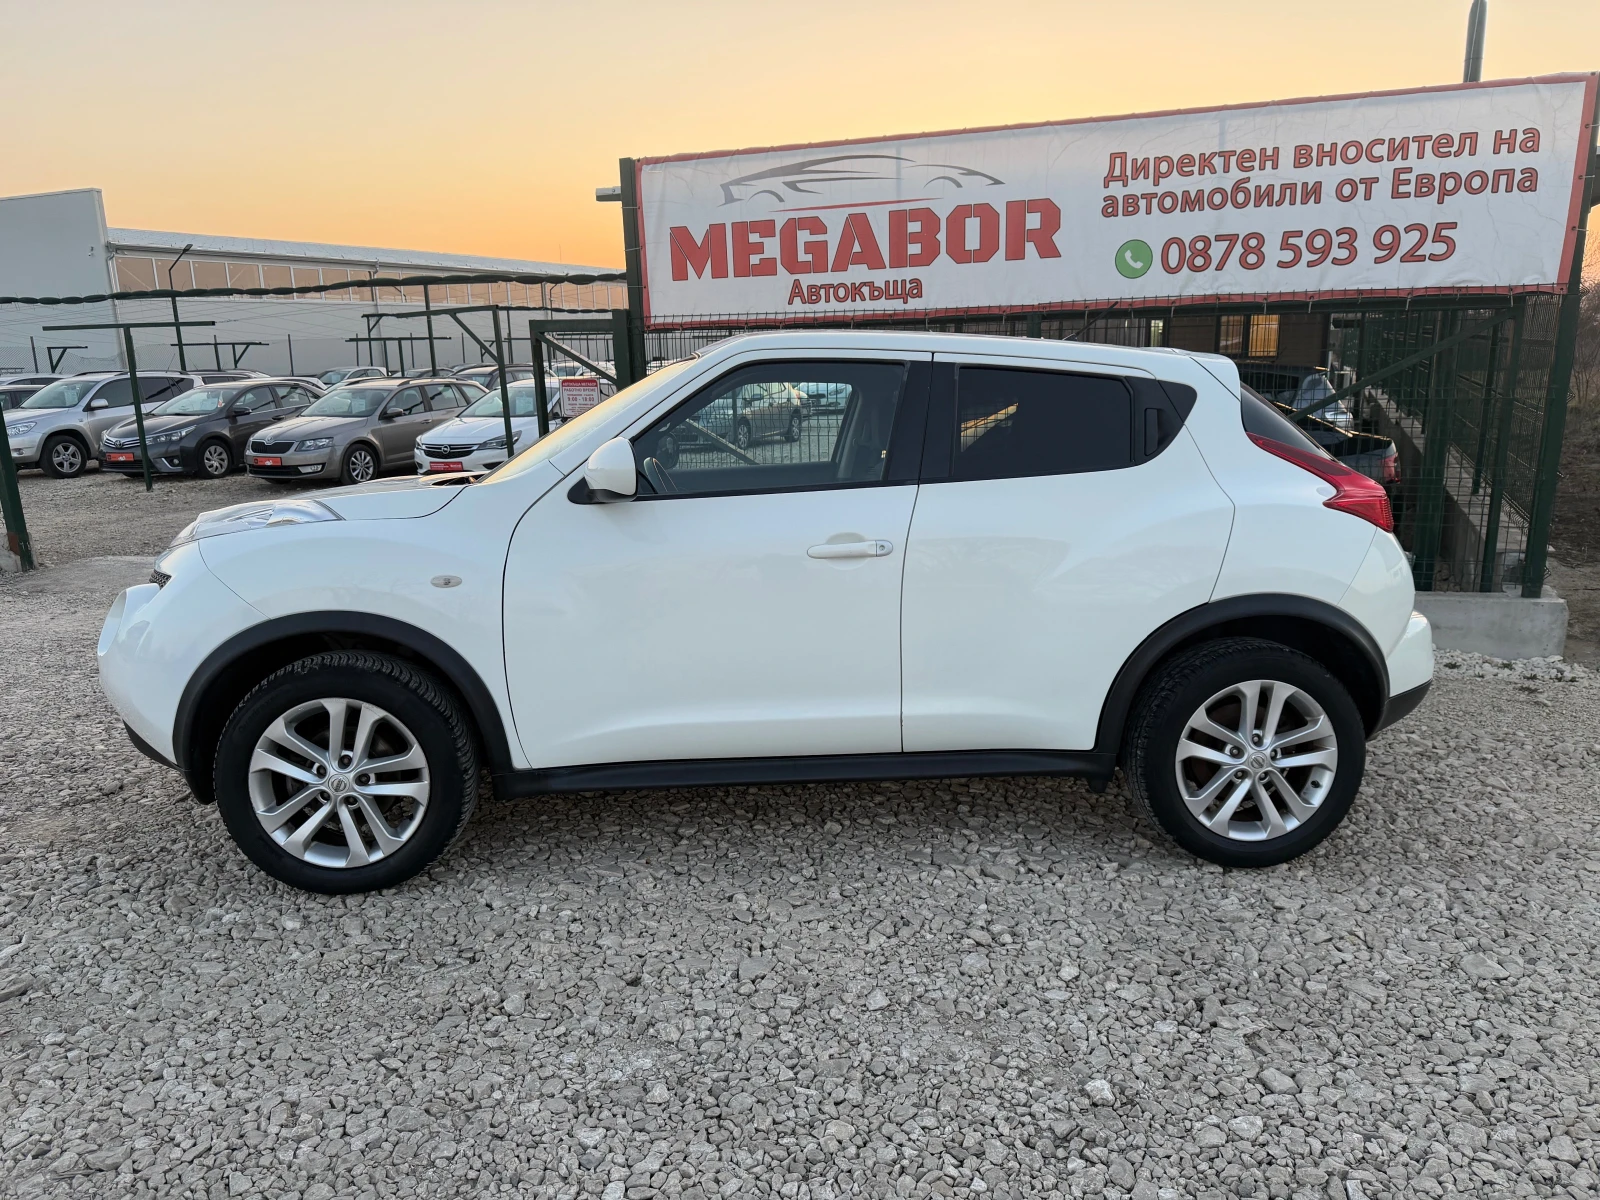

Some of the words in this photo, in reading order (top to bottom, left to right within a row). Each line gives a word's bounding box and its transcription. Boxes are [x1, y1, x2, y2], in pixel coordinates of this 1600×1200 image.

[1104, 146, 1279, 188] Директен
[1293, 132, 1478, 168] вносител
[1493, 128, 1541, 156] на
[1101, 176, 1323, 218] автомобили
[1335, 175, 1380, 203] от
[1391, 167, 1539, 205] Европа
[669, 198, 1062, 282] MEGABOR
[1161, 231, 1266, 275] 0878
[1277, 229, 1358, 268] 593
[1373, 222, 1458, 264] 925
[788, 277, 923, 305] Автокъща
